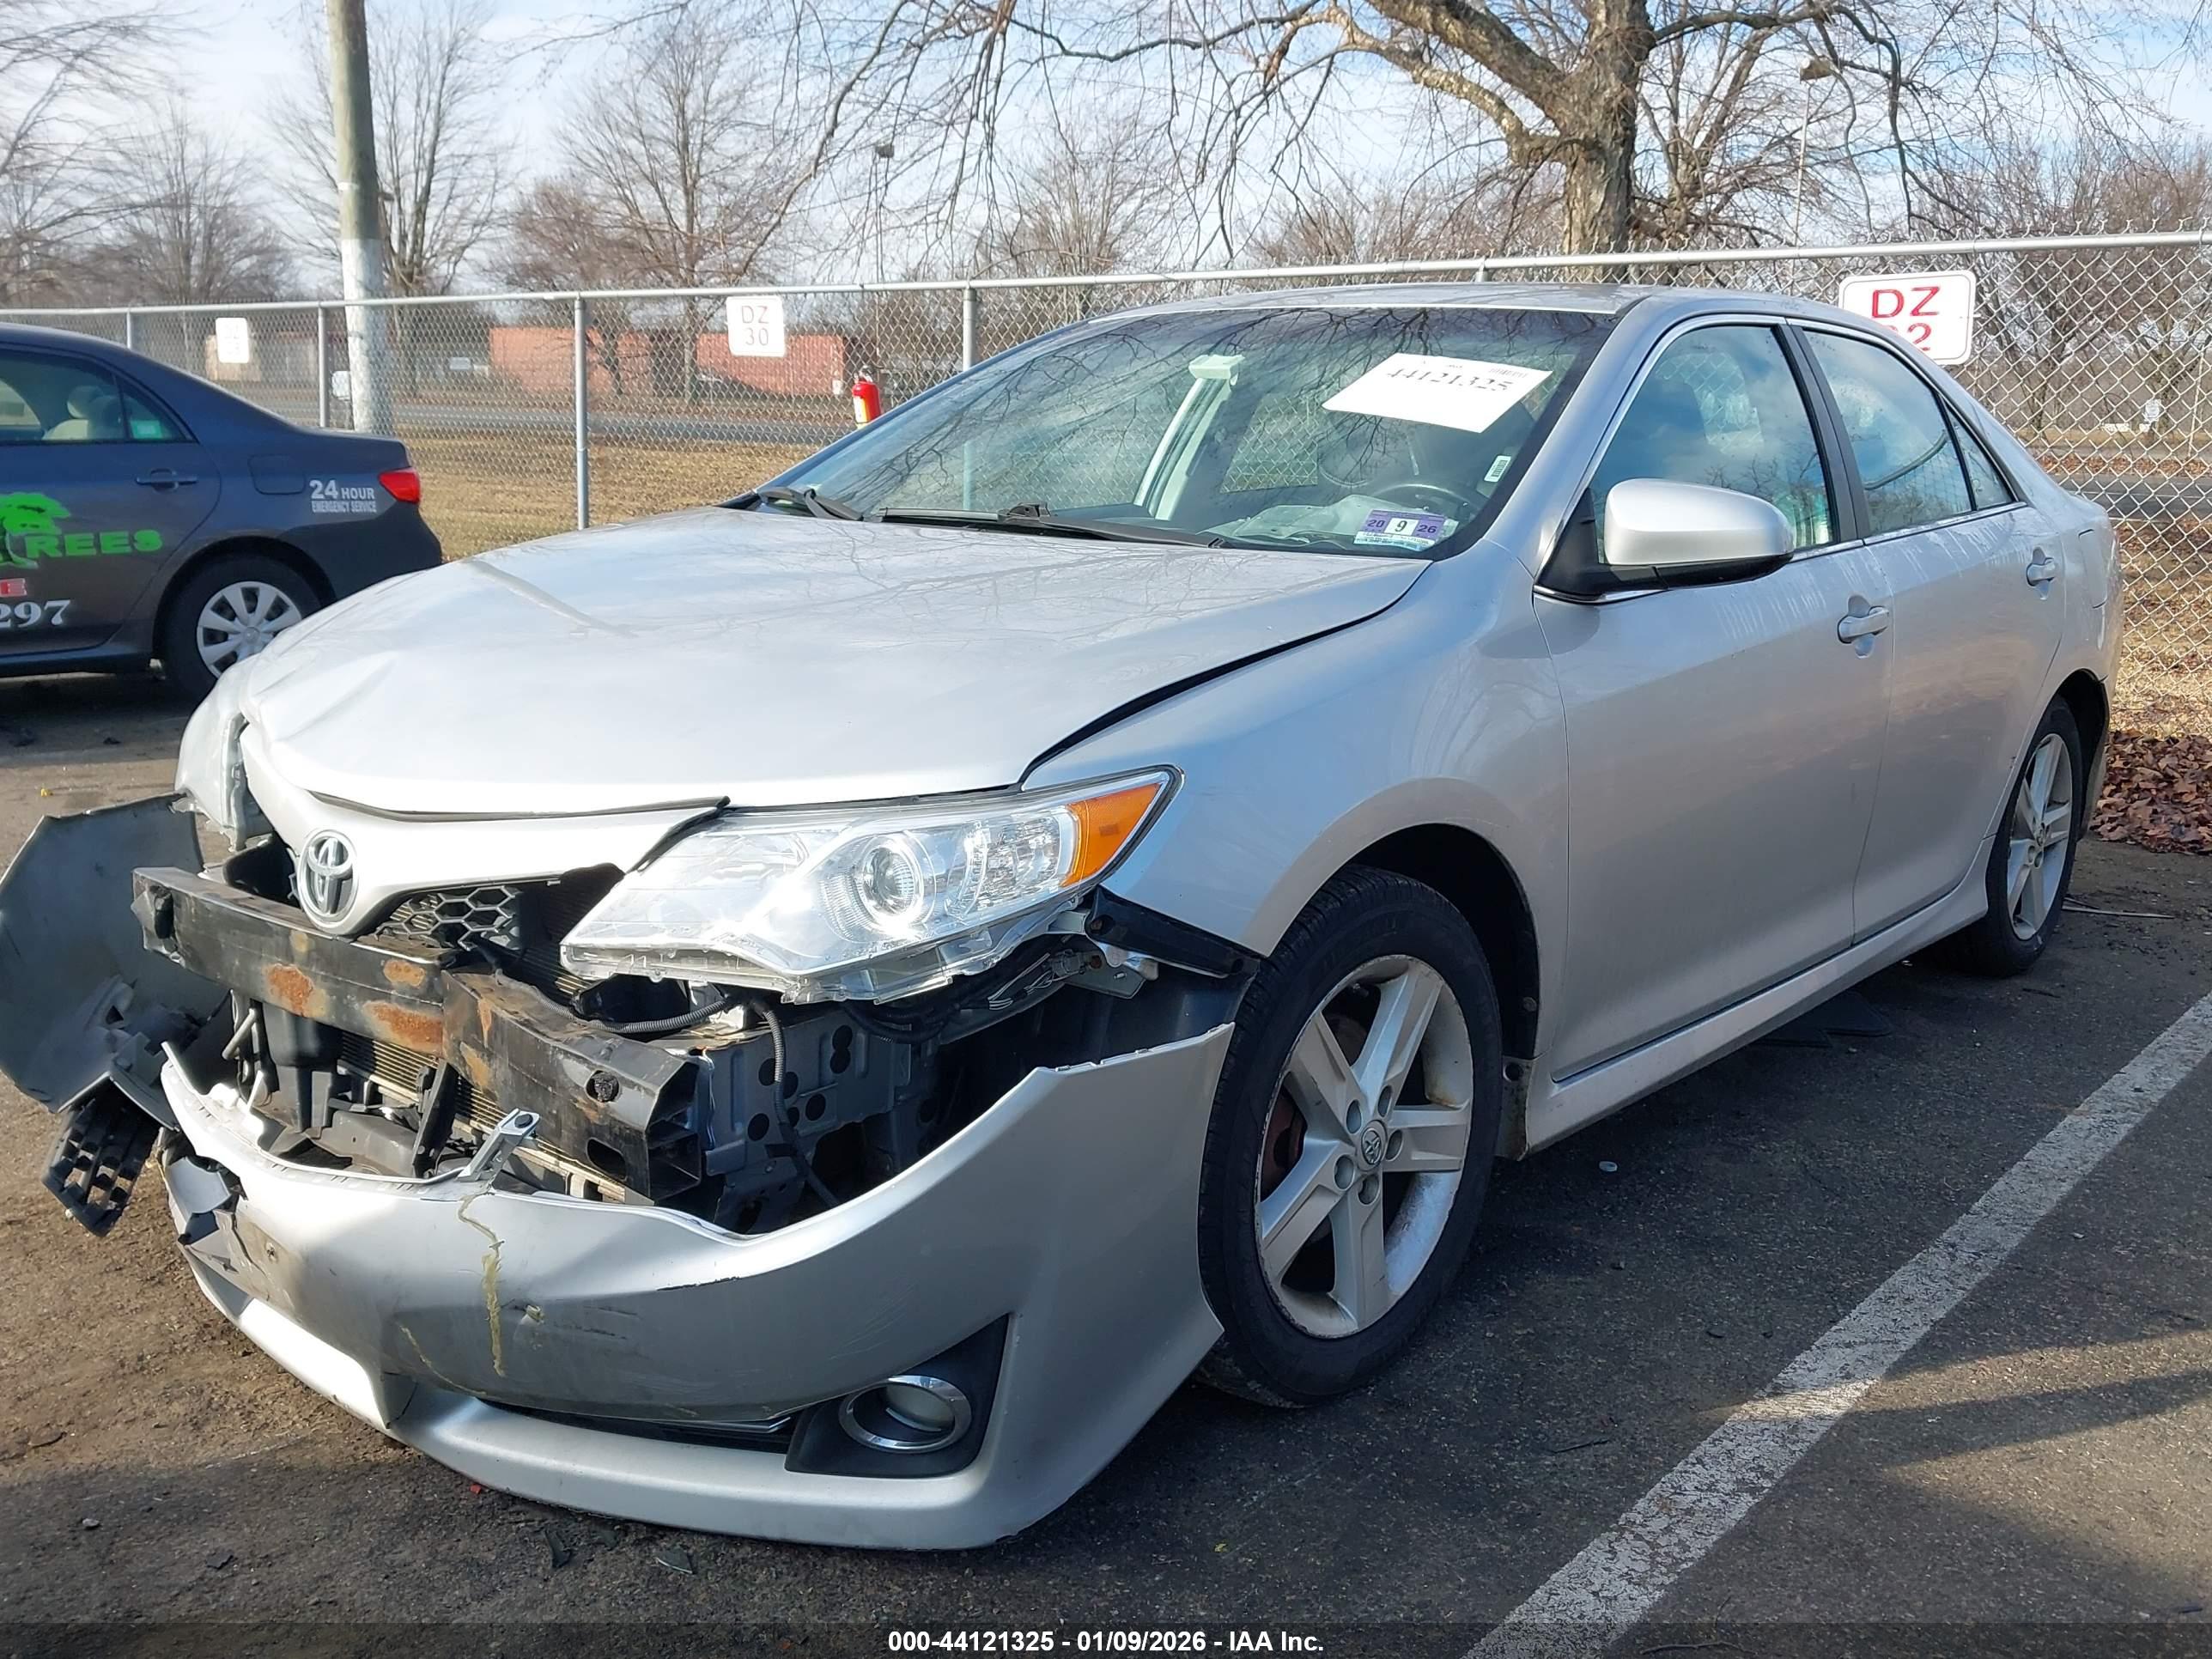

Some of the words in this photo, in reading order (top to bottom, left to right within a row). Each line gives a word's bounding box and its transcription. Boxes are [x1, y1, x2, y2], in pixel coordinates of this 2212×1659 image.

[1871, 286, 1941, 319] DZ
[741, 305, 770, 324] DZ
[743, 327, 769, 346] 30
[1882, 321, 1933, 351] 2
[309, 479, 339, 499] 24
[340, 487, 375, 500] HOUR
[1366, 519, 1386, 528] 20
[1394, 520, 1408, 532] 9
[1417, 524, 1437, 533] 26
